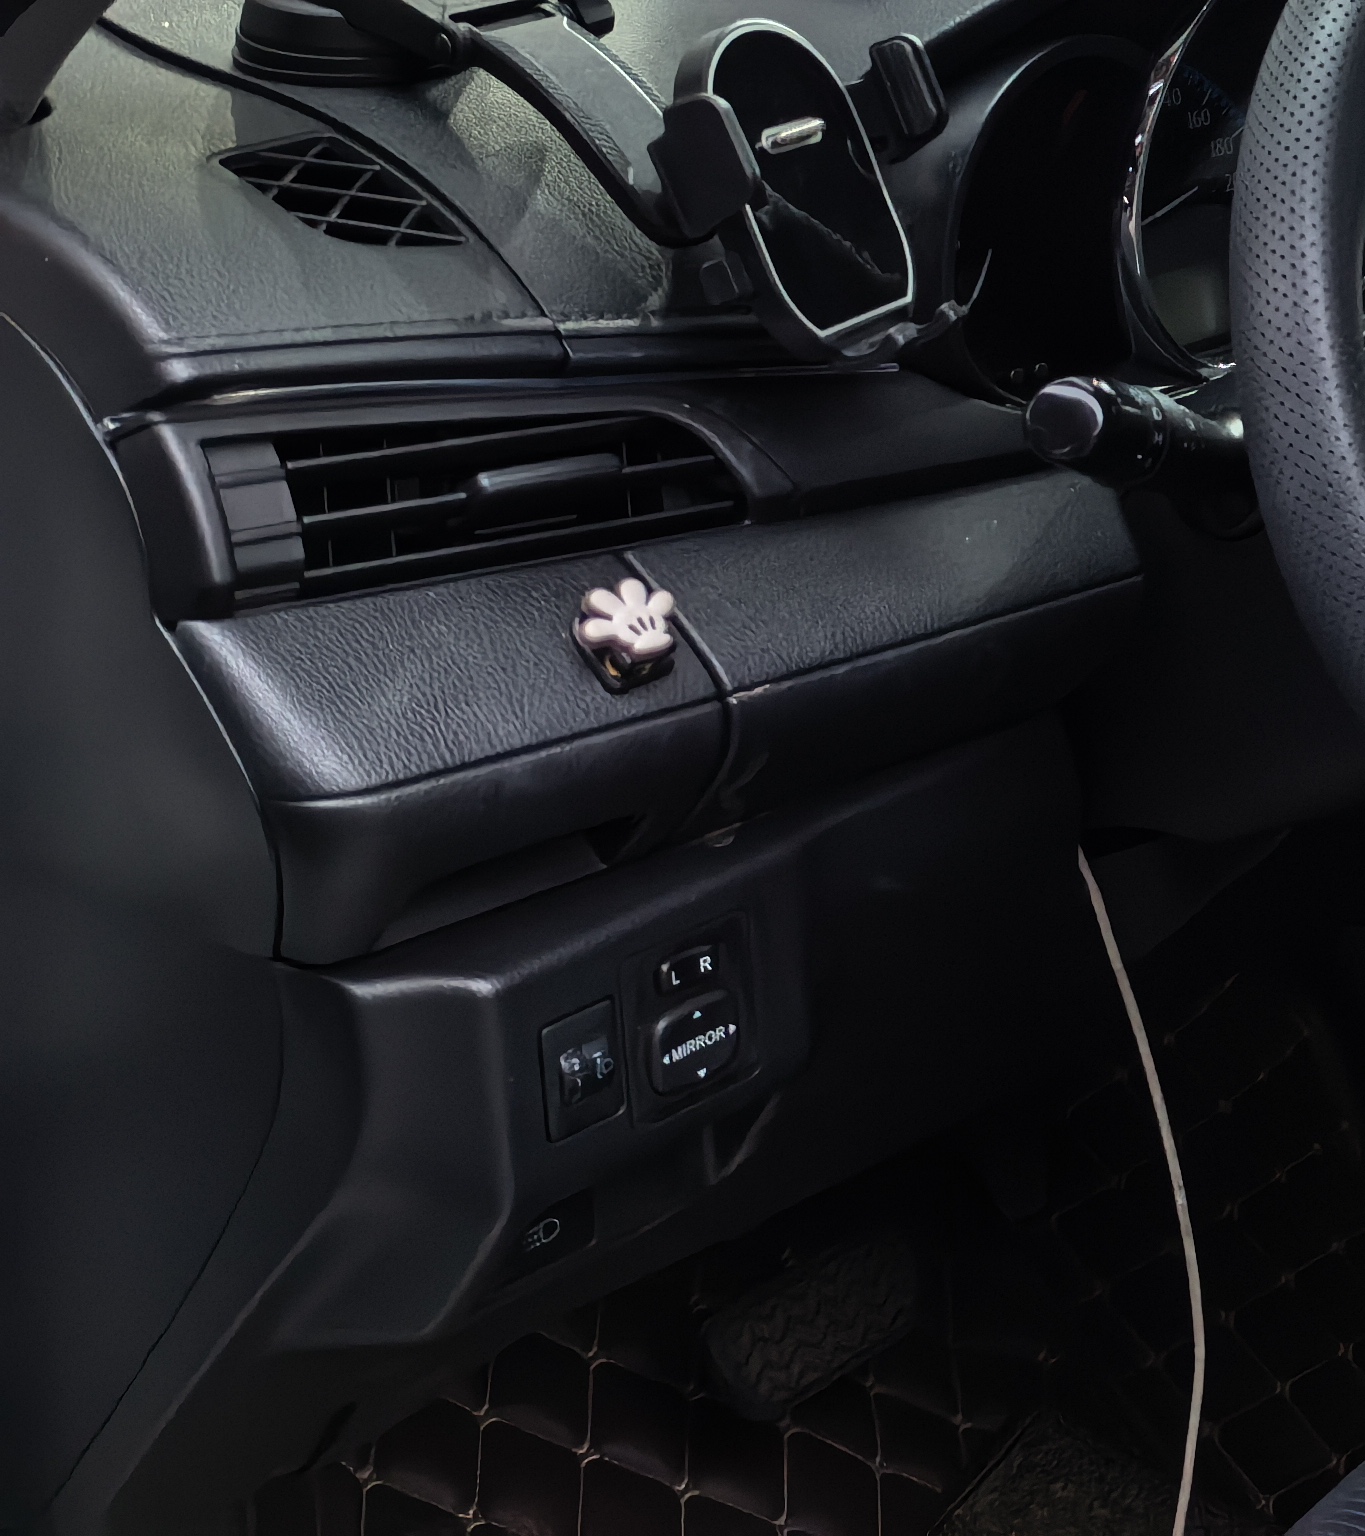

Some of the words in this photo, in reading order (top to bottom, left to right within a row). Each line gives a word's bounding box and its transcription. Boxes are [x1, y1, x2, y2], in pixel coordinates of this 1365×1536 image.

[1187, 108, 1211, 130] 160
[1210, 136, 1234, 158] 180
[671, 970, 681, 986] L
[699, 955, 713, 973] R
[671, 1025, 726, 1063] MIRROR
